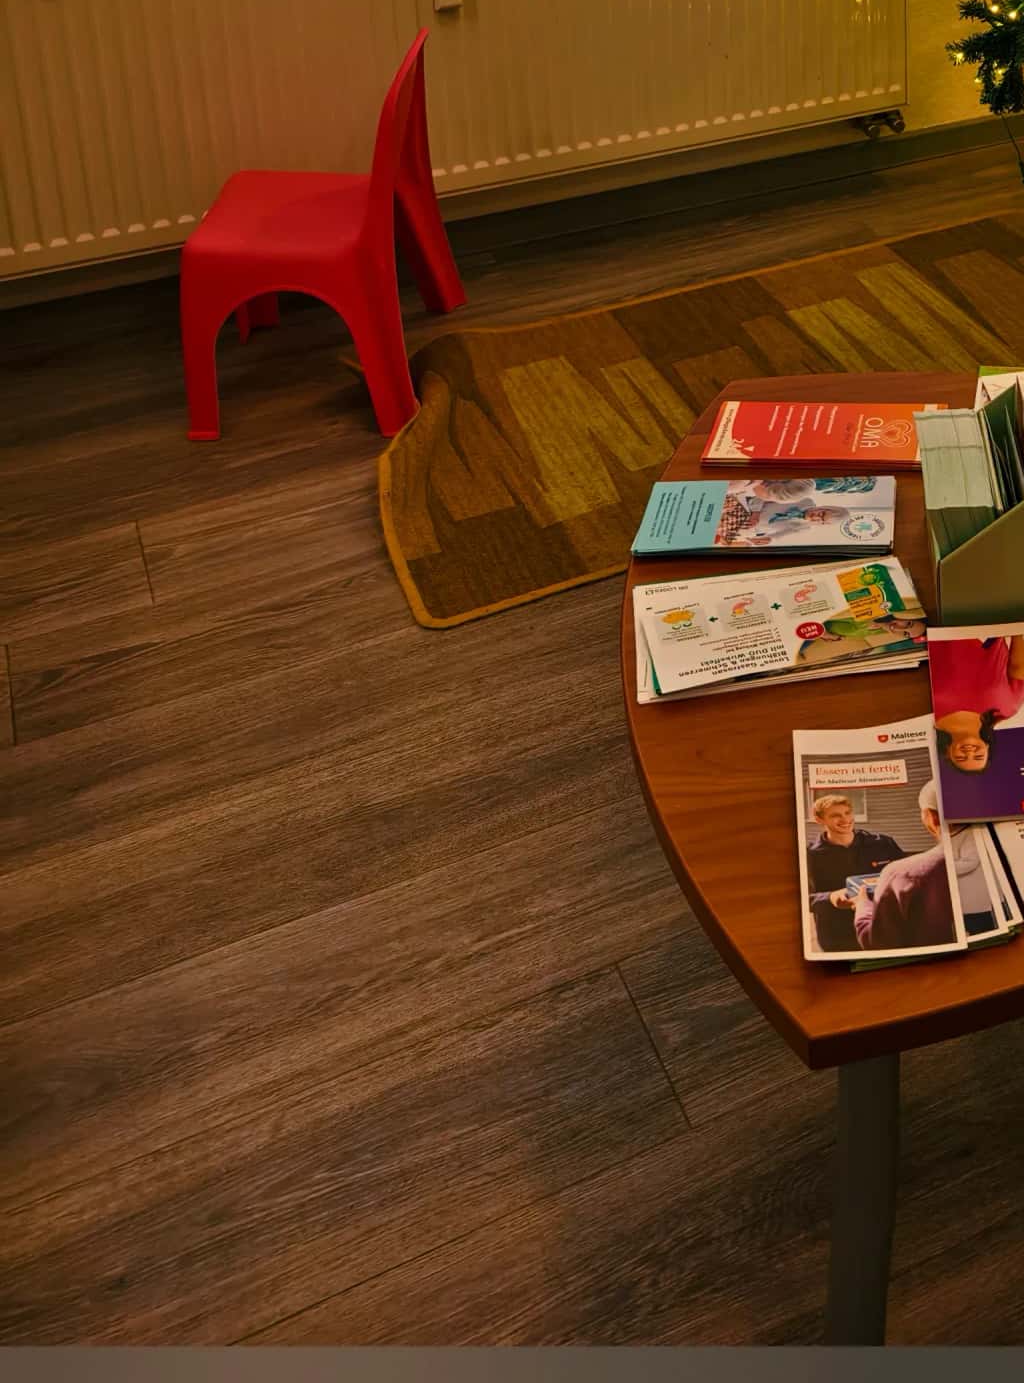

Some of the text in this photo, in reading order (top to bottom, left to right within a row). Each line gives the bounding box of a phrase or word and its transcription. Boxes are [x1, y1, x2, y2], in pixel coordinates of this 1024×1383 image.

[859, 417, 884, 448] OMA
[766, 644, 785, 653] mit
[738, 651, 788, 663] Blähungen
[678, 663, 729, 677] Schmerzen
[891, 730, 927, 741] Malteser
[815, 763, 901, 776] Essen ist fertig
